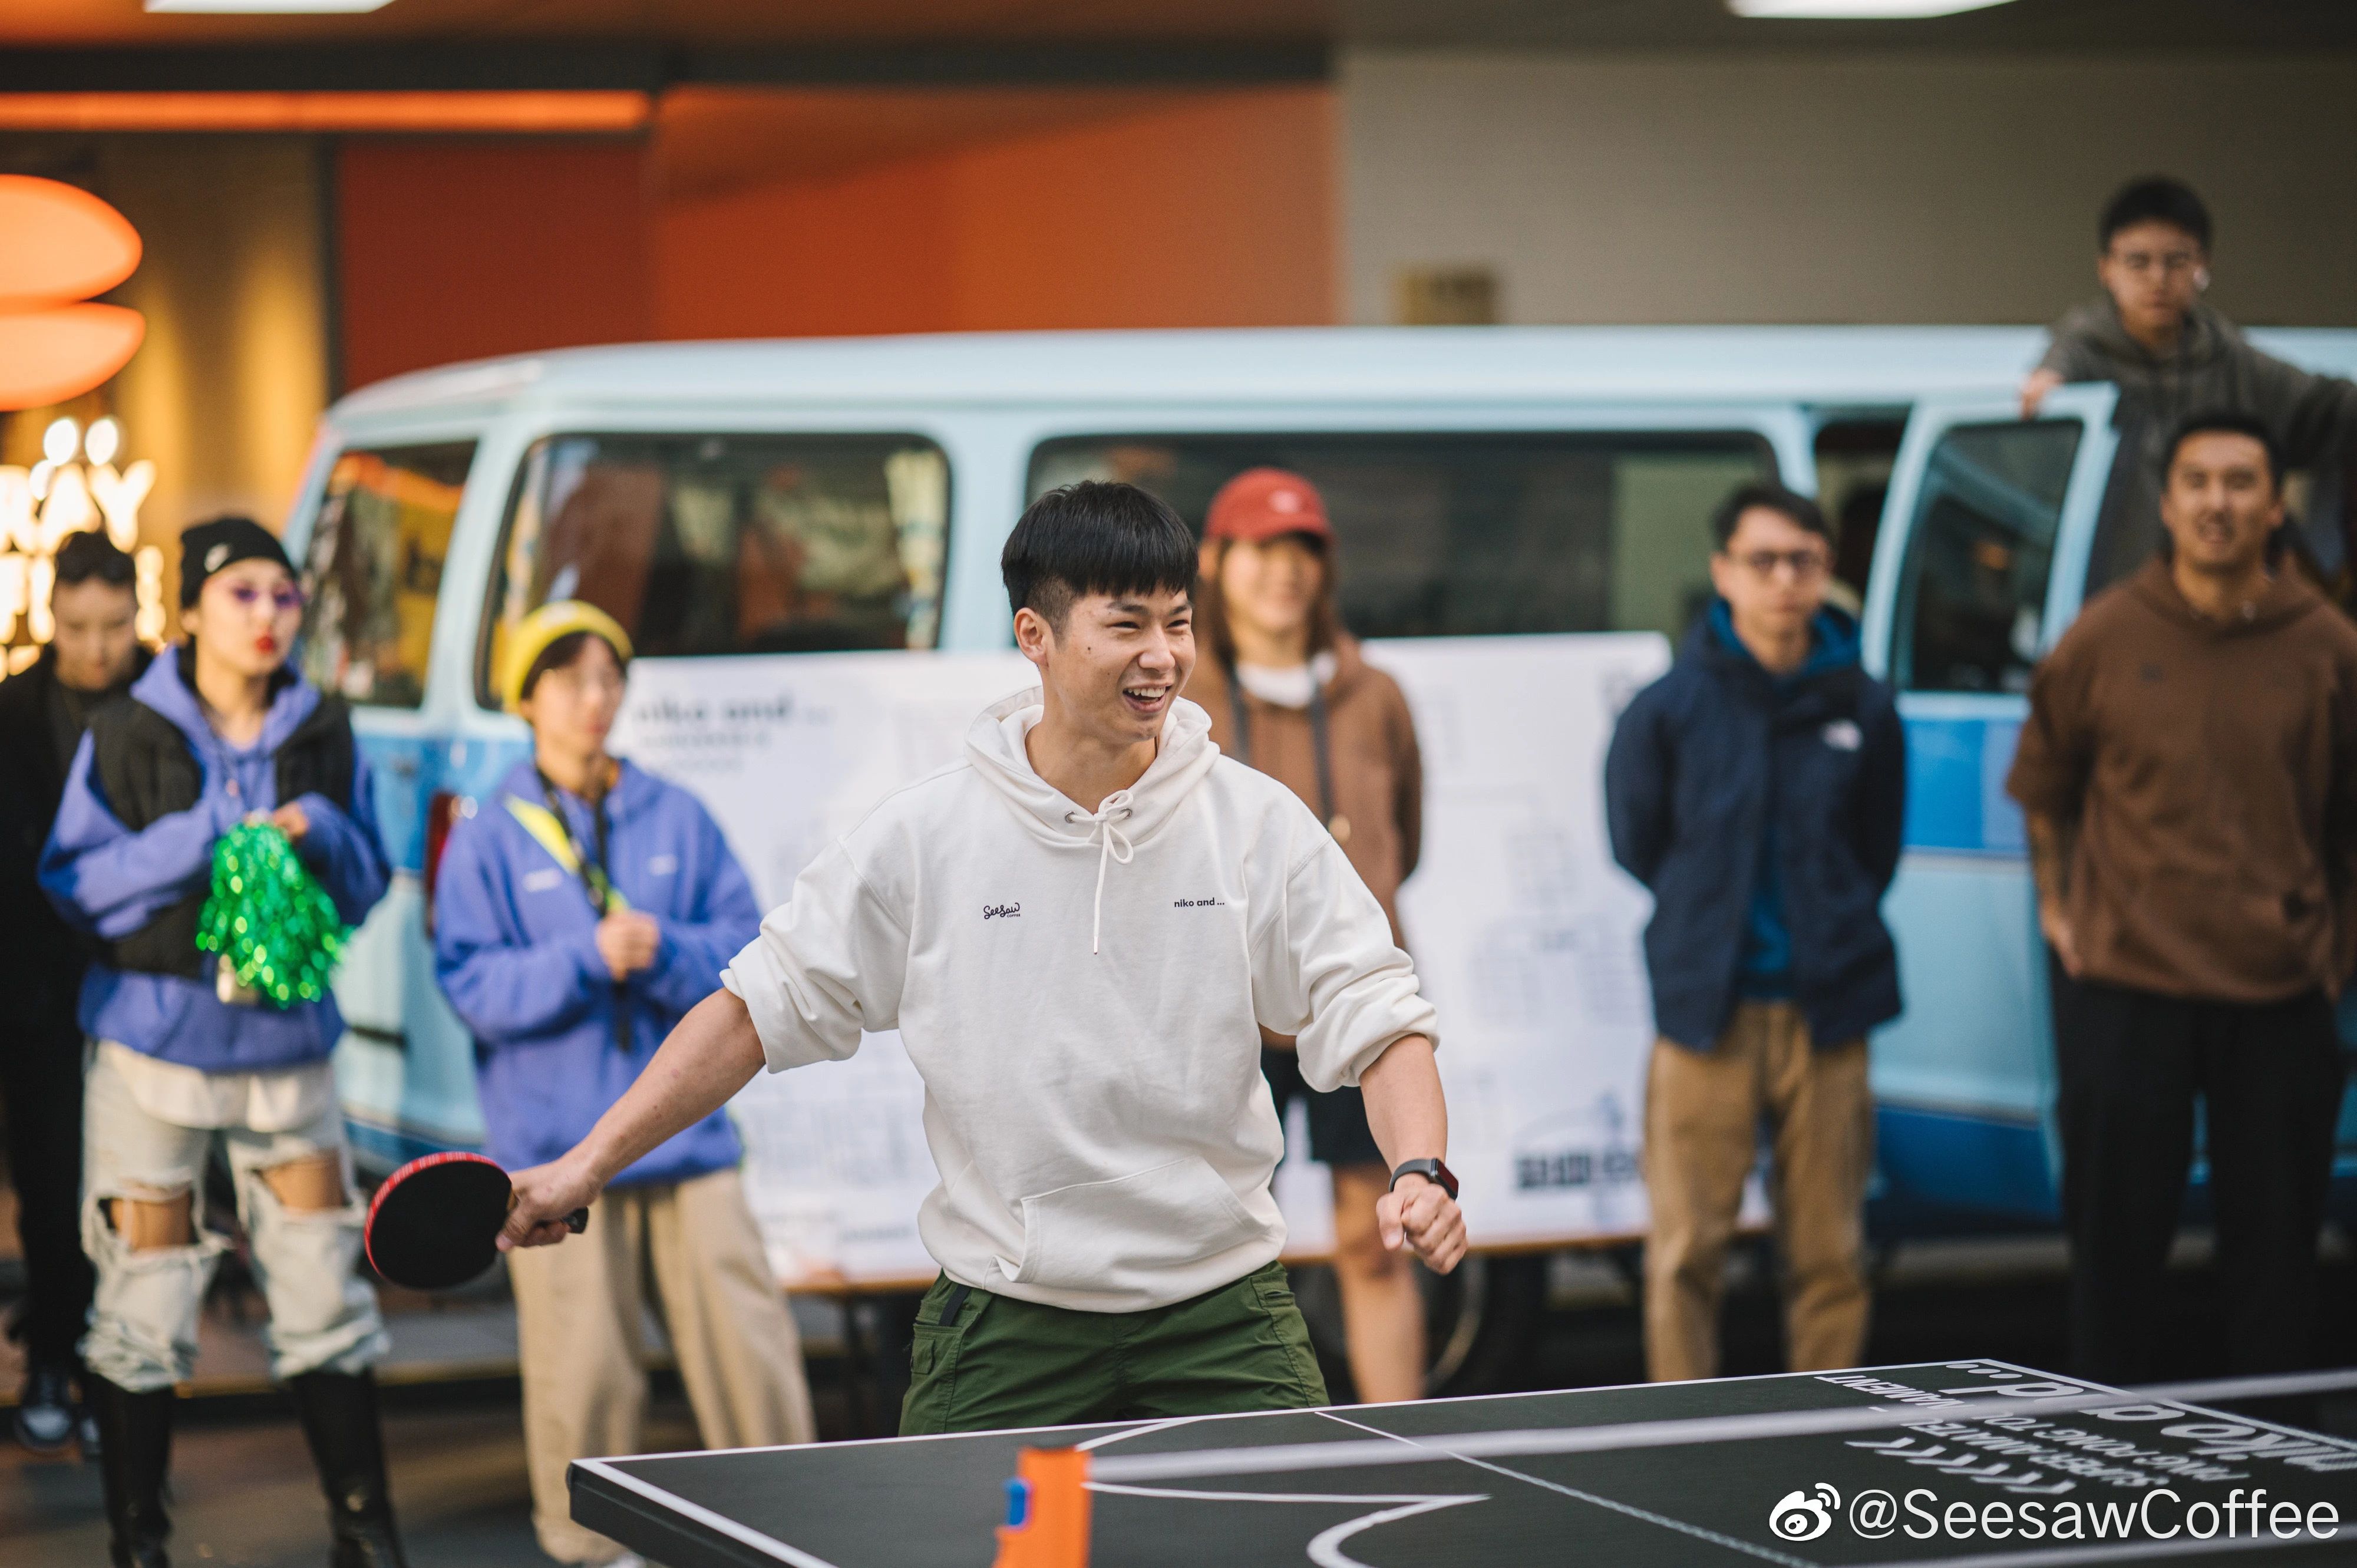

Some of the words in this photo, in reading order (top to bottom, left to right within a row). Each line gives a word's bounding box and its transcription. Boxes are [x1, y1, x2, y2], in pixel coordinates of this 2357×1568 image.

[1174, 899, 1194, 907] niko
[1814, 1375, 2056, 1432] TOUNAMENT
[1883, 1411, 2059, 1455] AMATEU
[2034, 1428, 2161, 1458] PONG
[2028, 1451, 2170, 1487] SUPER
[2132, 1454, 2252, 1482] PING
